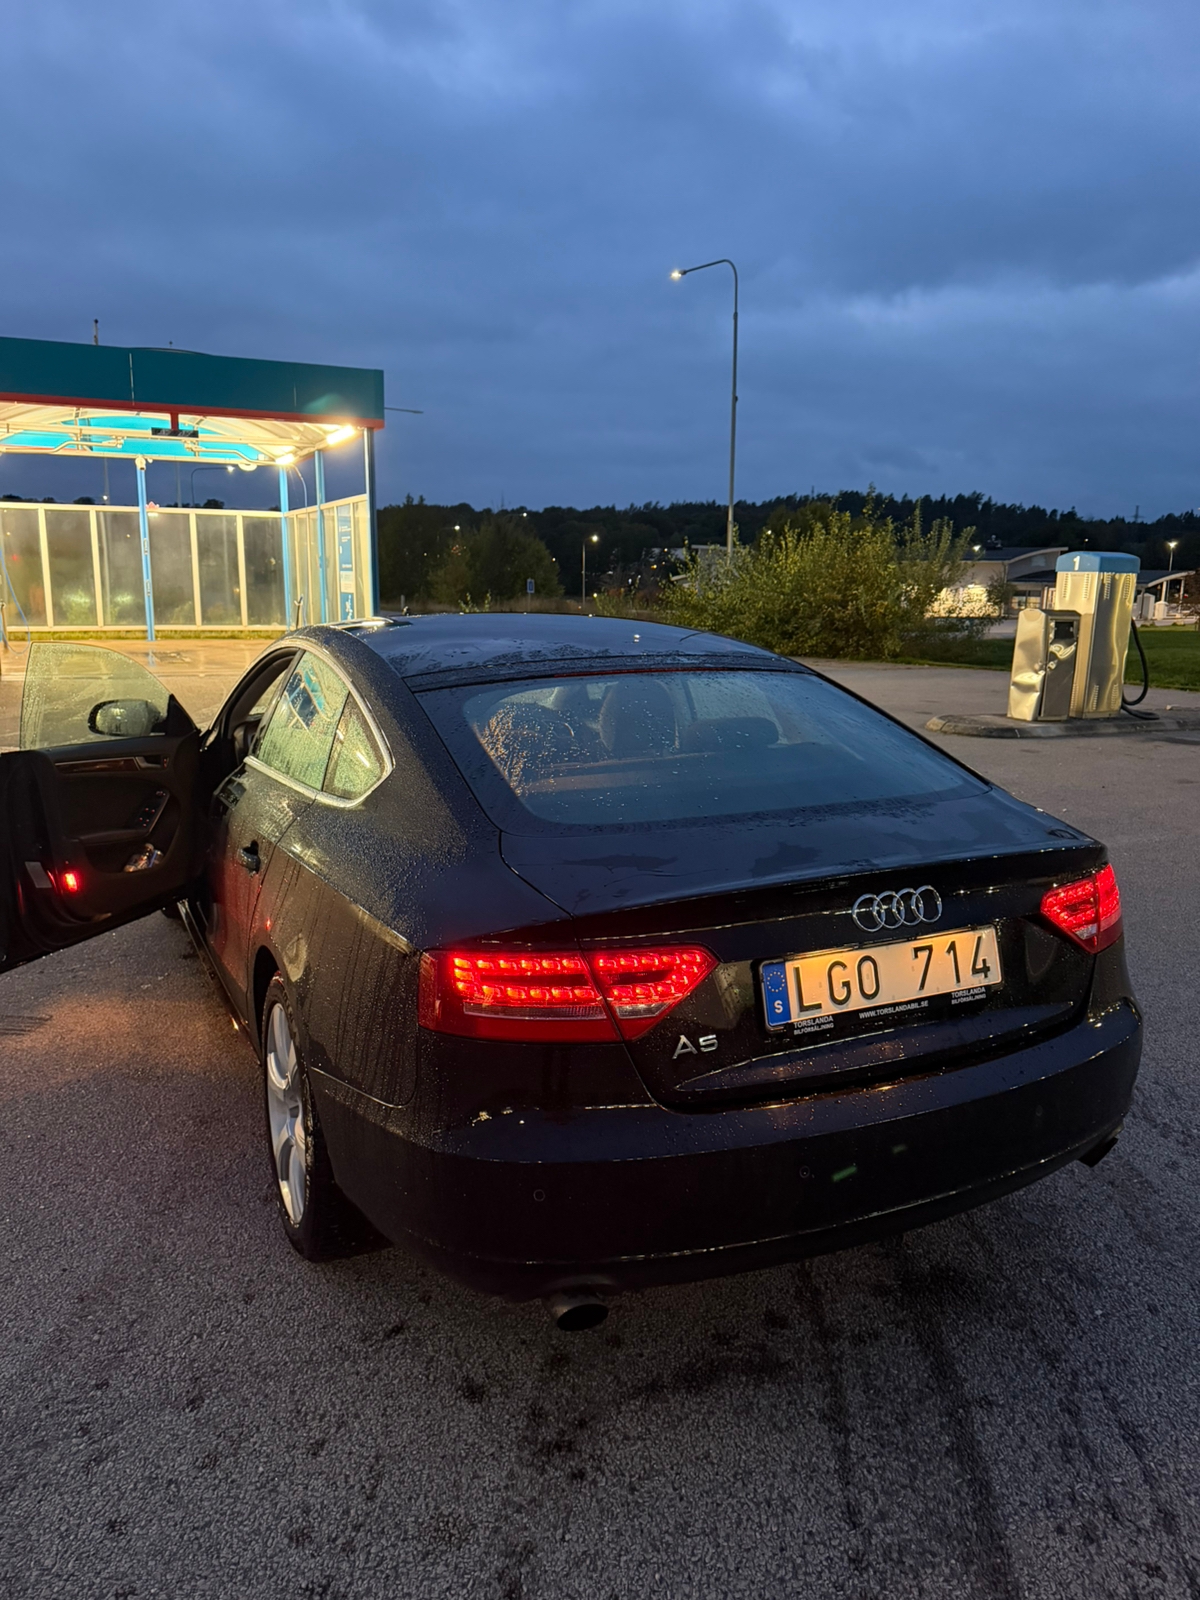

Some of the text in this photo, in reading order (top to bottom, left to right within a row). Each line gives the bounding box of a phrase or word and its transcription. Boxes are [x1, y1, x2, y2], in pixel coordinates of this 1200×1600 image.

[1073, 555, 1081, 571] 1
[793, 935, 991, 1013] LGO 714
[951, 986, 986, 998] TORSLANDA
[774, 1000, 784, 1013] S
[859, 1000, 929, 1019] WWW.TORSLANDABIL.SE
[793, 1015, 834, 1029] TORSLANDA
[672, 1034, 719, 1059] A5
